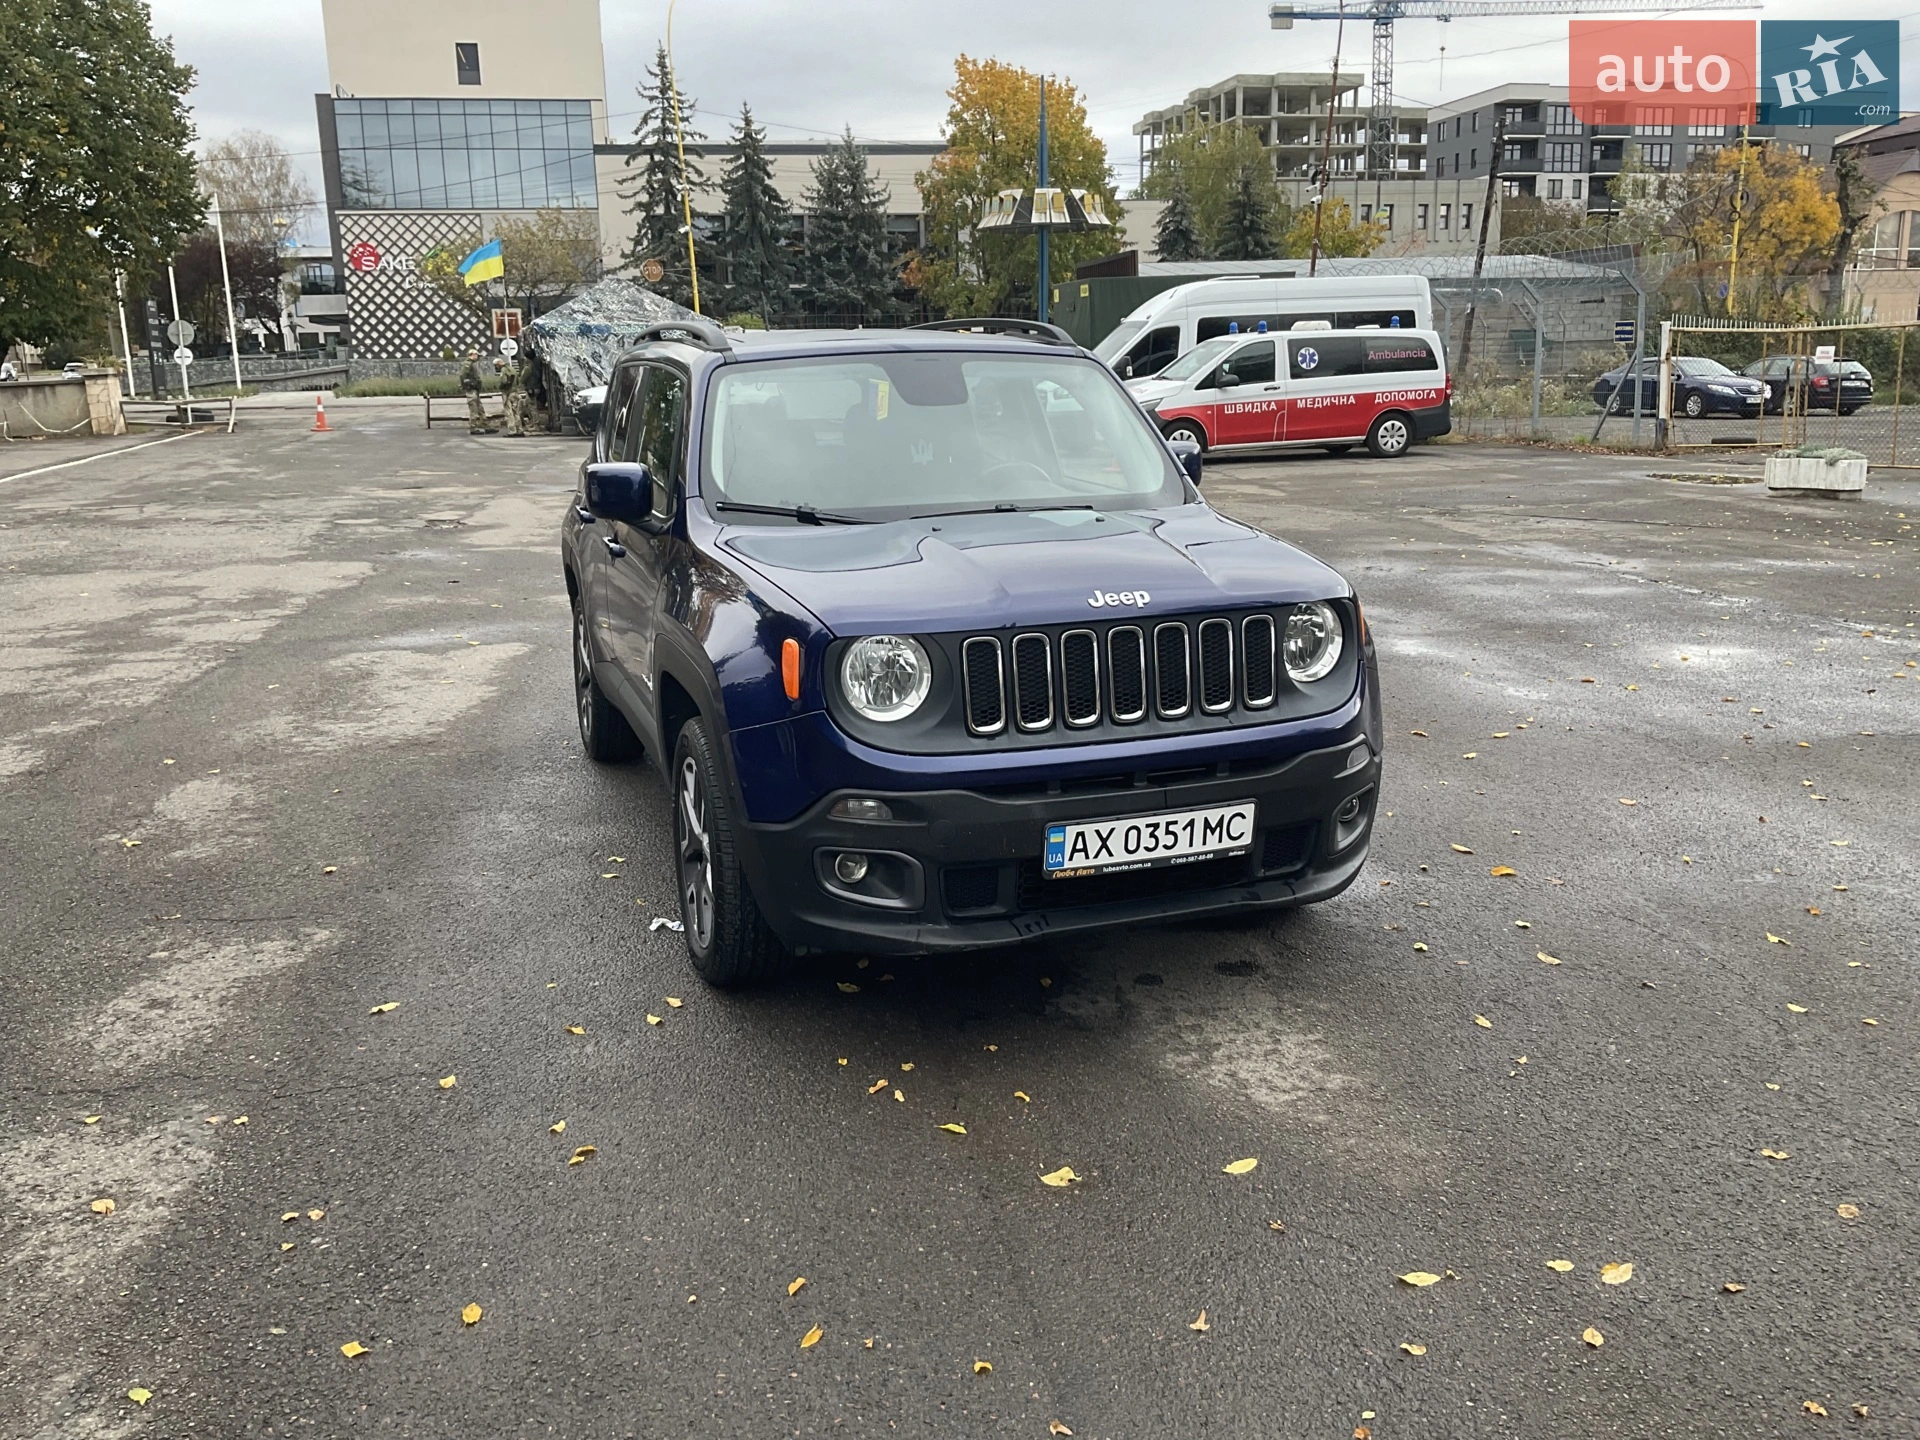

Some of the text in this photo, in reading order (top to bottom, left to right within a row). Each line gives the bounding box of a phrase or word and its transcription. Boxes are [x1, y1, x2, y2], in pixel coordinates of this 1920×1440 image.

[361, 256, 415, 271] SAKE
[643, 266, 662, 275] STOP
[1368, 348, 1427, 361] Ambulancia
[1224, 390, 1437, 414] ШВИДКА МЕДИЧНА ДОПОМОГА
[1087, 590, 1151, 608] Jeep
[1048, 853, 1063, 863] UA
[1103, 862, 1152, 872] lubeavto.com.ua
